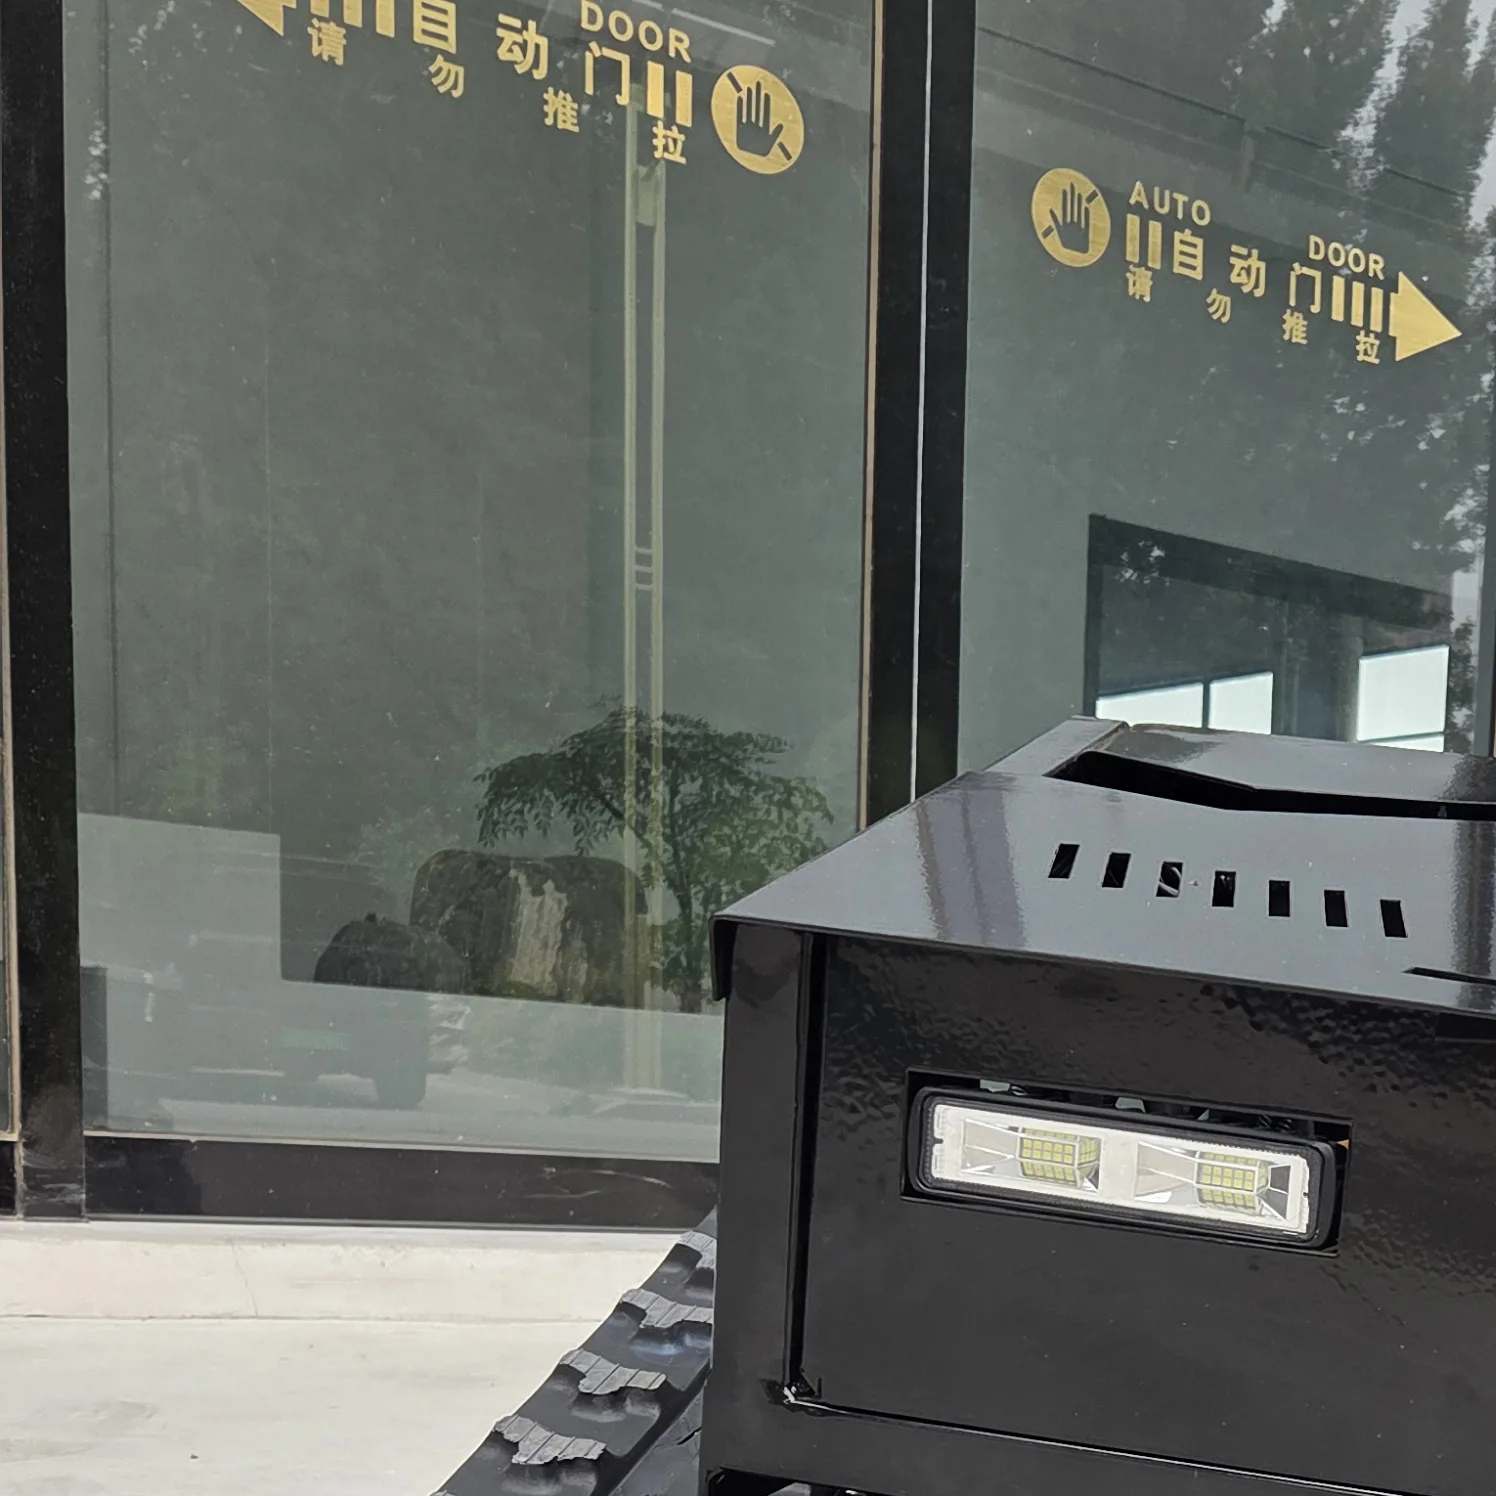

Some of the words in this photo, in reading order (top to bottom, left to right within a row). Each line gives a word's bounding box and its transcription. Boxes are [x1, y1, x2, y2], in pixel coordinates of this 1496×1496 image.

[413, 0, 631, 106] 自动门
[580, 0, 692, 63] DOOR
[307, 18, 687, 165] 请勿推拉
[1129, 180, 1212, 227] AUTO
[1173, 228, 1322, 315] 自动门
[1309, 235, 1384, 279] DOOR
[1126, 265, 1380, 365] 请勿推拉
